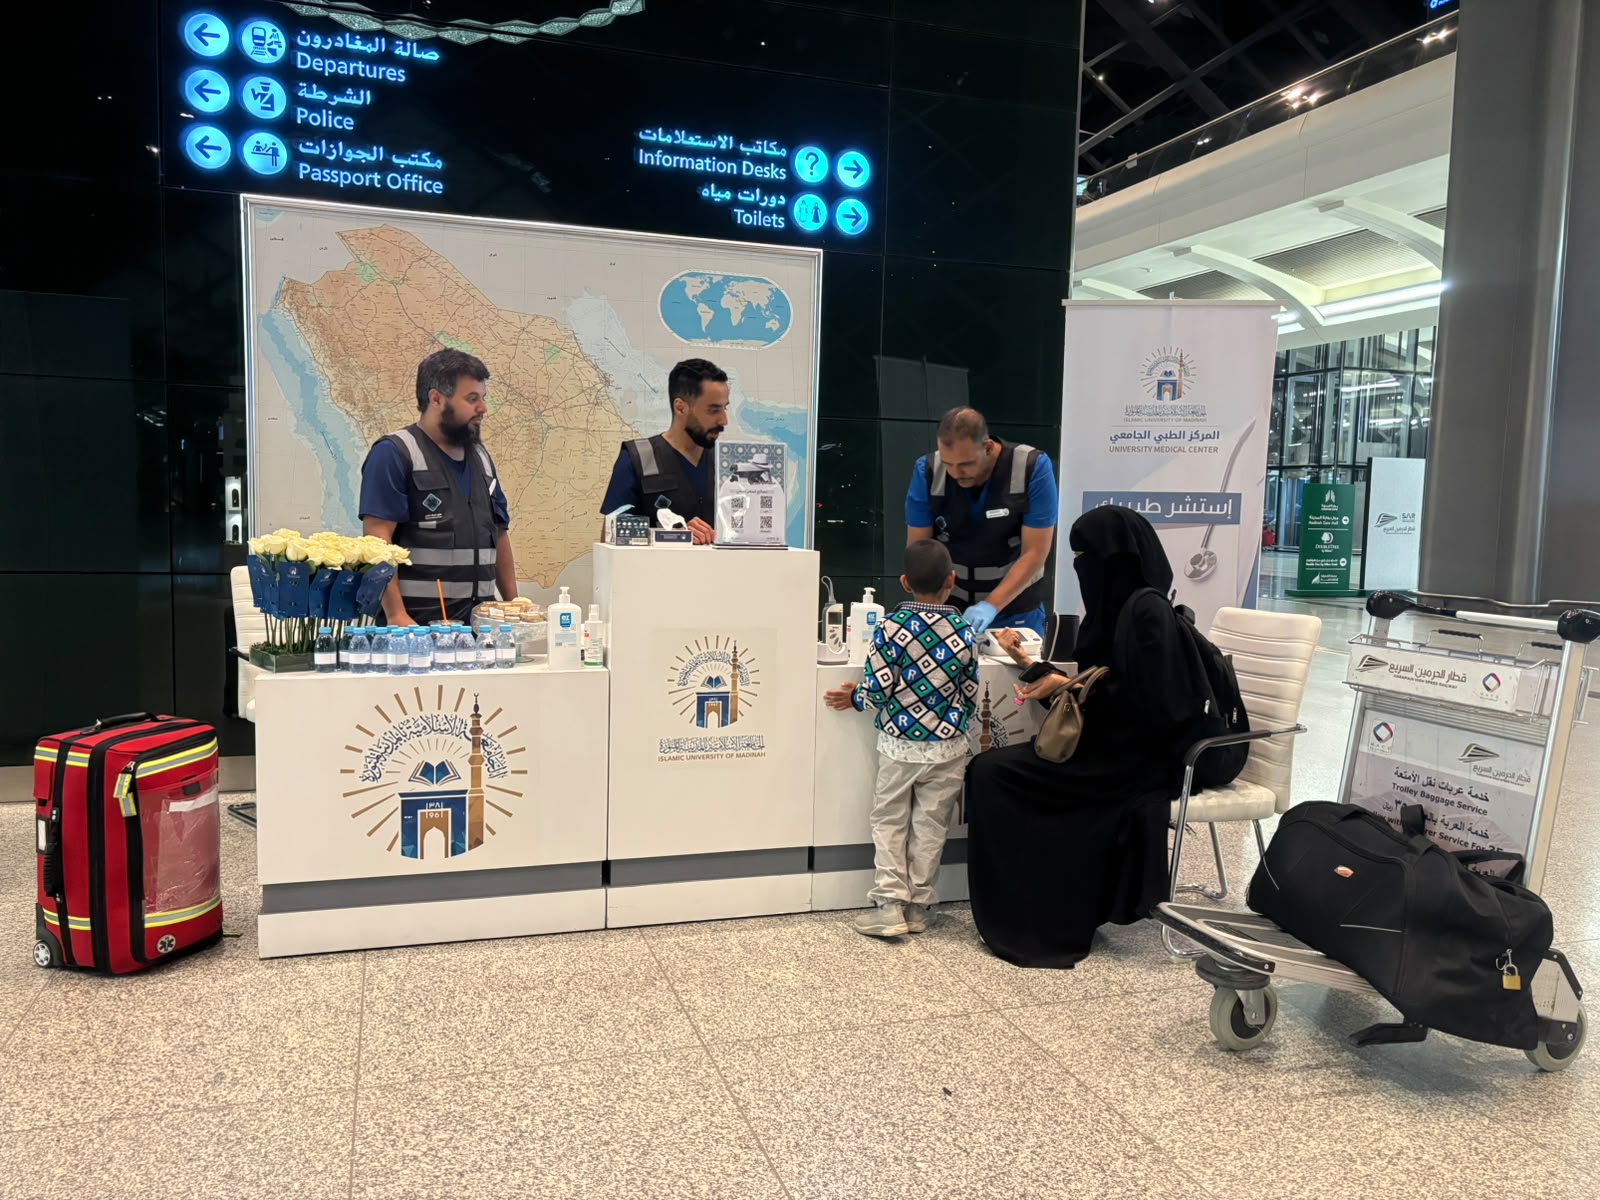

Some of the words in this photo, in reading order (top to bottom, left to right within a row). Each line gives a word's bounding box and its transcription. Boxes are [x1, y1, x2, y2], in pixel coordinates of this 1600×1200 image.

[296, 30, 386, 53] المغادرون
[394, 41, 440, 61] صالة
[296, 52, 406, 82] Departures
[297, 83, 372, 106] الشرطة
[296, 107, 355, 130] Police
[298, 139, 384, 164] الجوازات
[740, 140, 787, 158] مكاتب
[392, 151, 443, 170] مكتب
[638, 149, 737, 175] Information
[742, 160, 787, 180] Desks
[298, 163, 381, 188] Passport
[386, 172, 444, 194] Office
[701, 183, 732, 202] مياه
[737, 188, 786, 206] دورات
[733, 208, 785, 229] Toilets
[1109, 430, 1151, 444] الجامعي
[1154, 430, 1186, 444] الطبي
[1188, 430, 1220, 442] المركز
[911, 620, 920, 632] R
[964, 630, 972, 642] R
[907, 669, 917, 680] R
[1388, 664, 1415, 674] السريع
[1414, 667, 1446, 681] الحرمين
[1446, 670, 1468, 684] قطار
[898, 715, 908, 726] R
[949, 712, 959, 722] R
[685, 753, 724, 761] UNIVERSITY
[1394, 767, 1420, 783] الأمتعة
[1422, 776, 1437, 788] نقل
[1438, 780, 1464, 796] عربات
[1468, 786, 1490, 802] خدمة
[1392, 782, 1419, 797] Trolley
[1420, 790, 1455, 807] Baggage
[1456, 801, 1488, 816] Service
[1440, 814, 1465, 831] العربة
[1468, 823, 1490, 840] خدمة
[1438, 832, 1470, 848] Service
